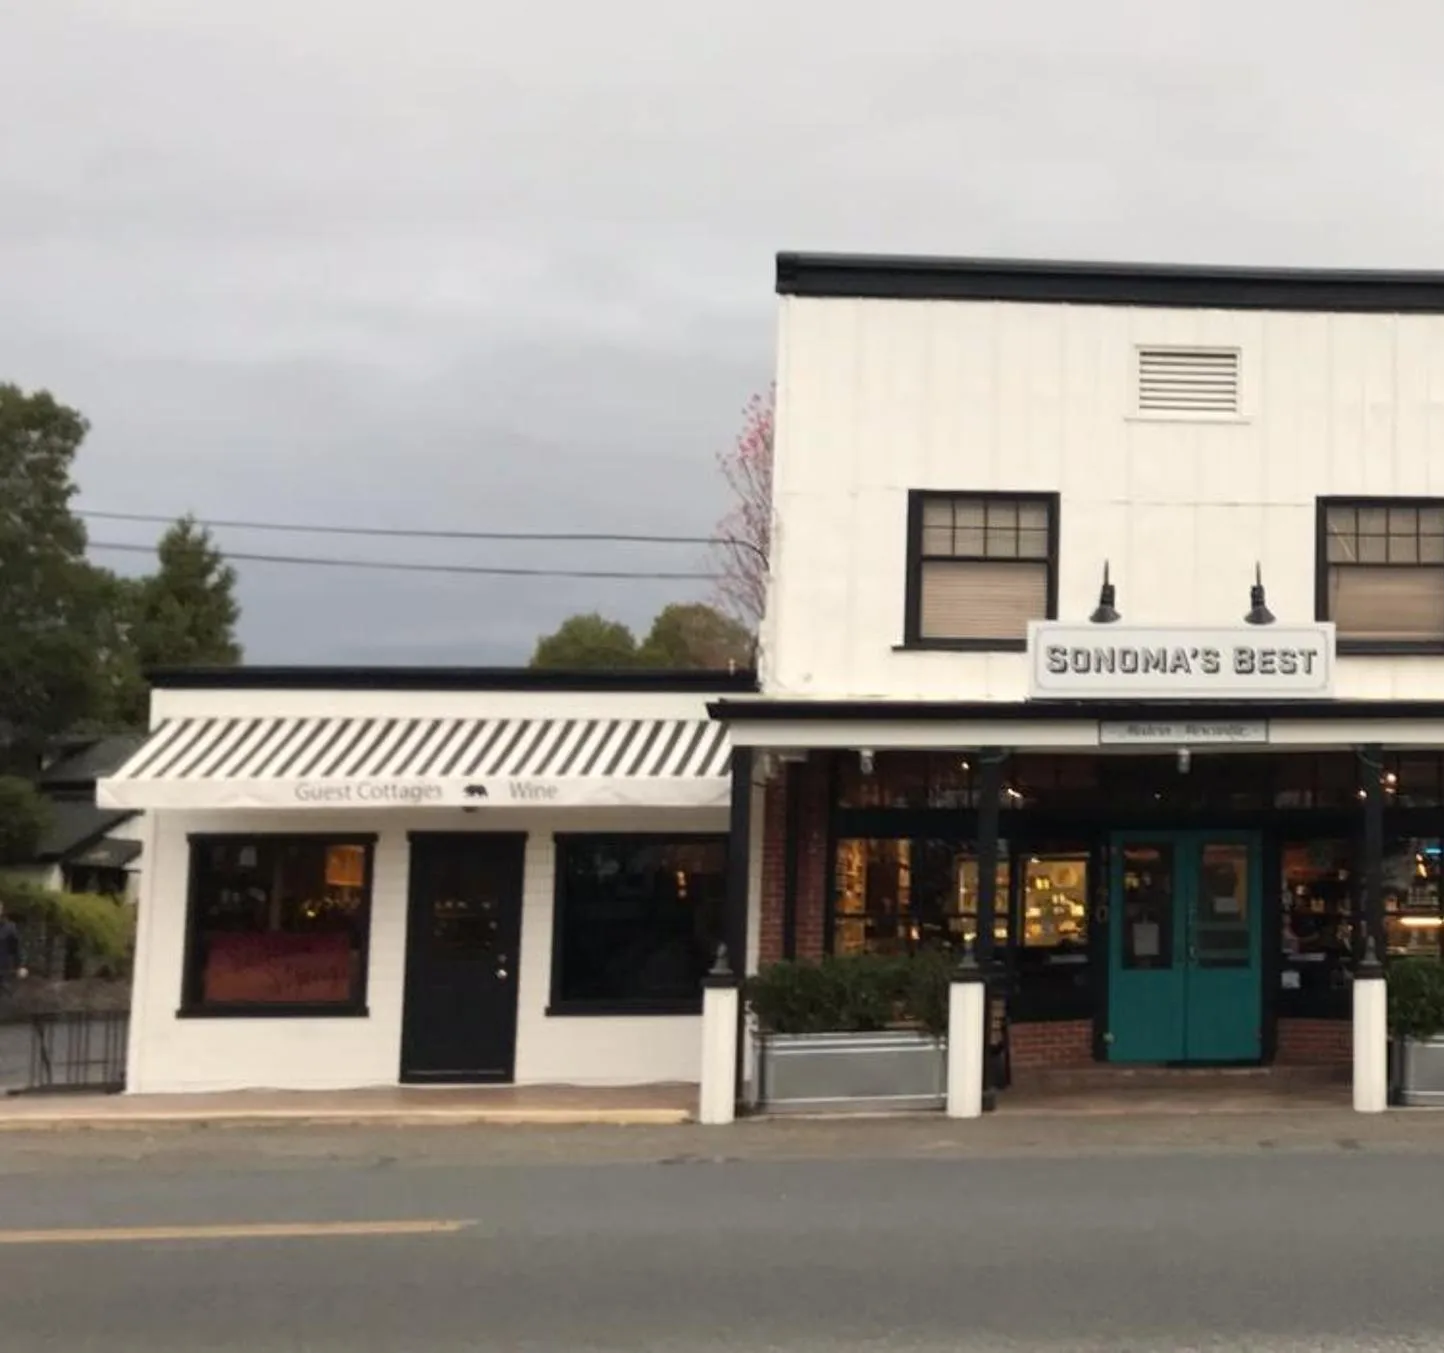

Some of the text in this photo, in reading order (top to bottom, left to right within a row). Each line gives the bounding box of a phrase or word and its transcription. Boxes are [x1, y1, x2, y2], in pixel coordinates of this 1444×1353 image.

[1046, 645, 1318, 676] SONOMA'S BEST
[294, 780, 559, 803] Guest Cottages Wine
